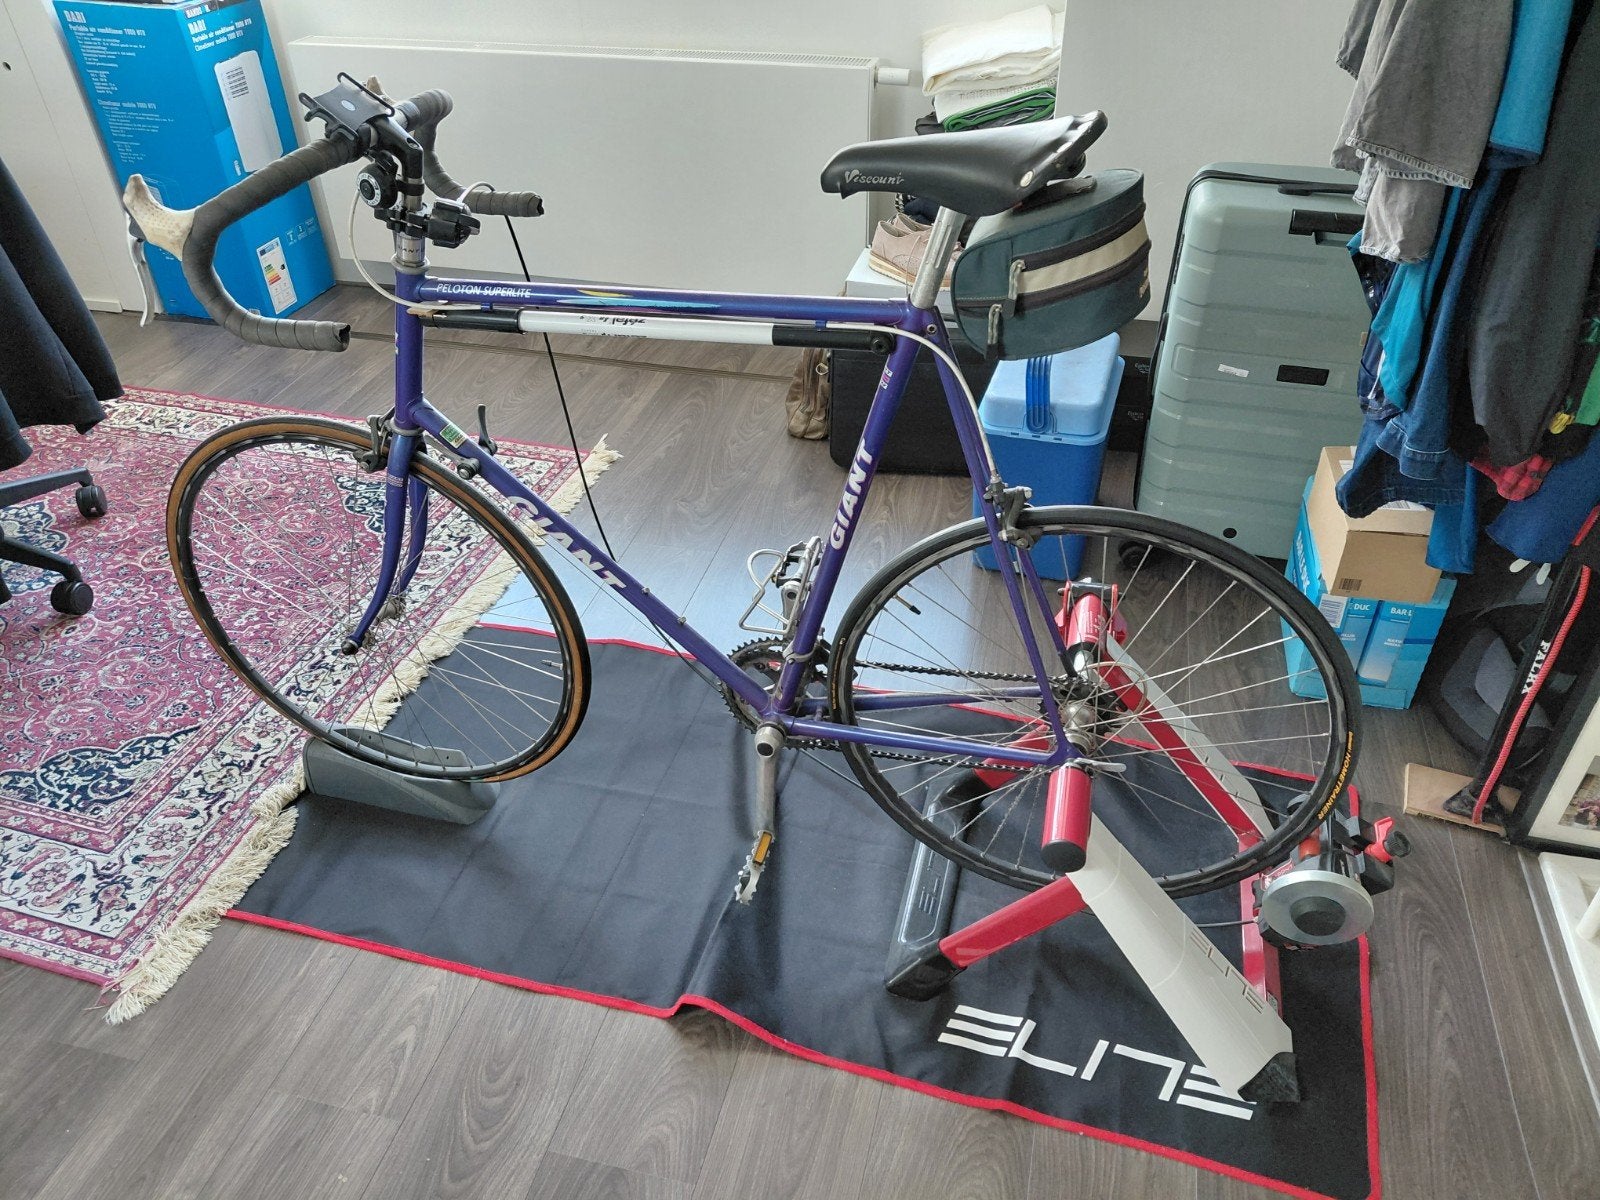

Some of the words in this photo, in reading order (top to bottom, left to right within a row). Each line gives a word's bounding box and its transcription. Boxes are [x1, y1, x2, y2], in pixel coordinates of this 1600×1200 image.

[844, 169, 904, 185] Viscount
[436, 283, 481, 295] PELOTON
[482, 286, 531, 298] SUPERLITE
[831, 439, 873, 550] GIANT
[1318, 751, 1352, 820] HOMETRAINER
